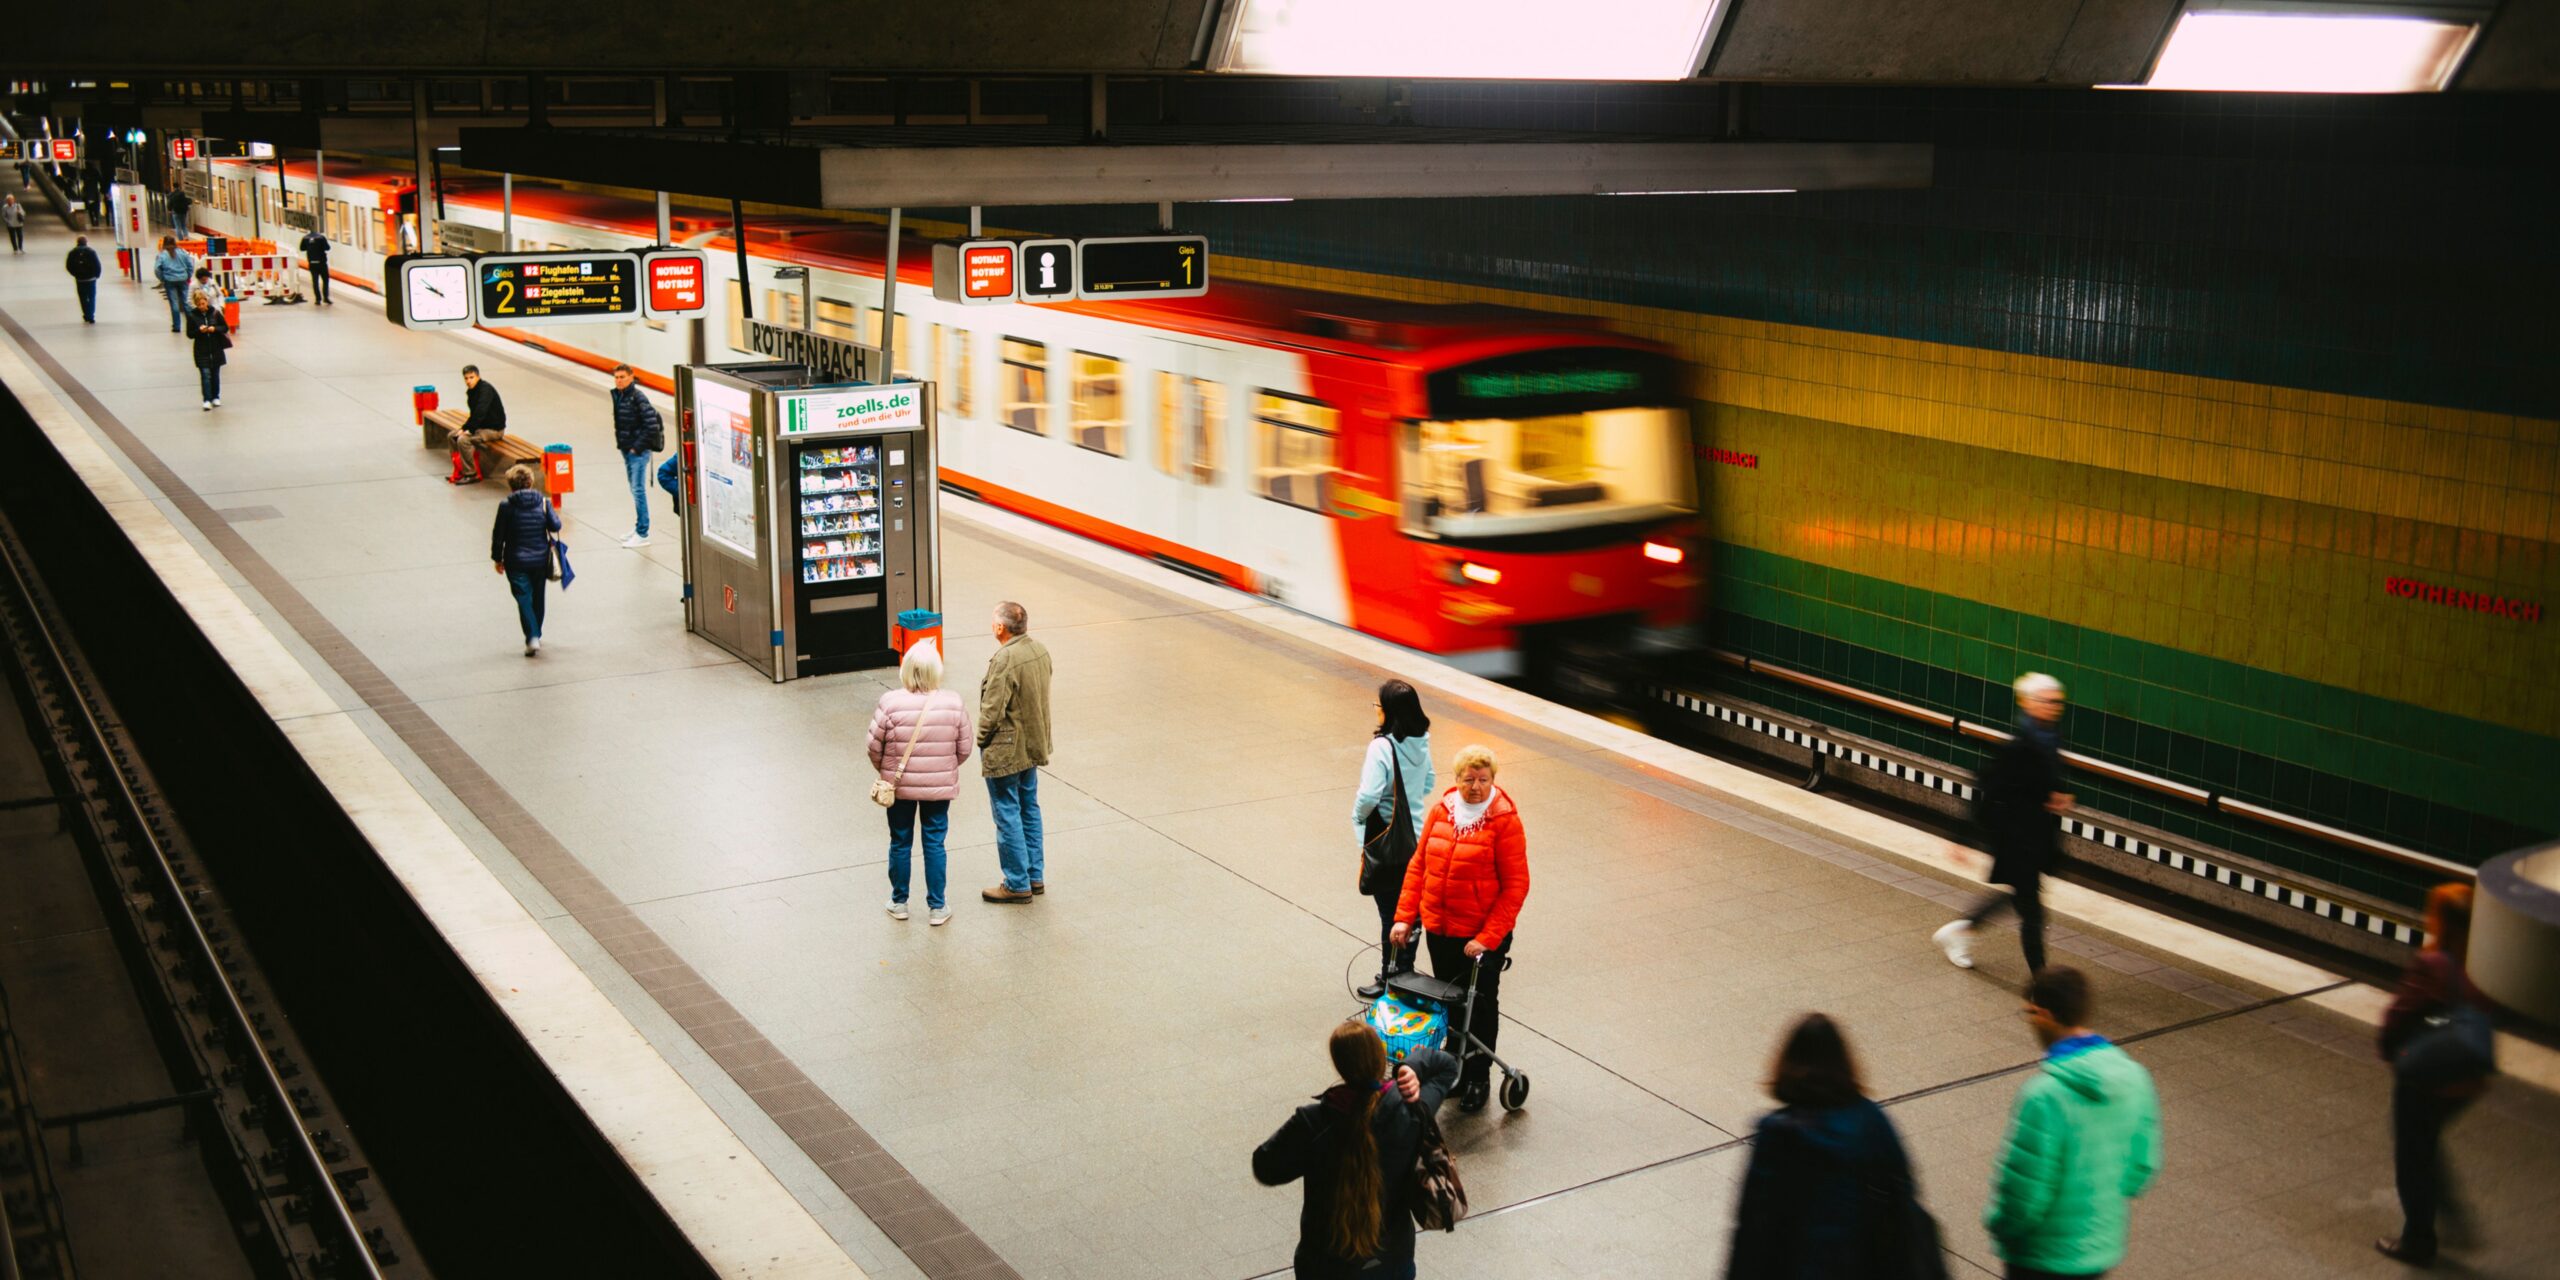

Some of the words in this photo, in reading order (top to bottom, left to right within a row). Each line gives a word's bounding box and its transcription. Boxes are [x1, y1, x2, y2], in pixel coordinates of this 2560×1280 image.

[1178, 246, 1196, 255] Gleis
[970, 254, 1005, 265] NOTHALT
[493, 268, 515, 279] Gleis
[540, 264, 580, 277] Flughafen
[612, 263, 618, 273] 4
[656, 265, 695, 276] NOTHALT
[970, 267, 1006, 277] NOTRUF
[1182, 256, 1192, 285] 1
[612, 284, 619, 295] 9
[656, 278, 696, 290] NOTRUF
[496, 280, 516, 314] 2
[541, 286, 585, 299] Ziegelstein
[752, 321, 867, 381] RÖTHENBACH
[836, 394, 911, 419] zoells.de
[838, 417, 860, 428] rund
[862, 416, 876, 424] um
[878, 412, 893, 421] die
[895, 409, 912, 418] Uhr
